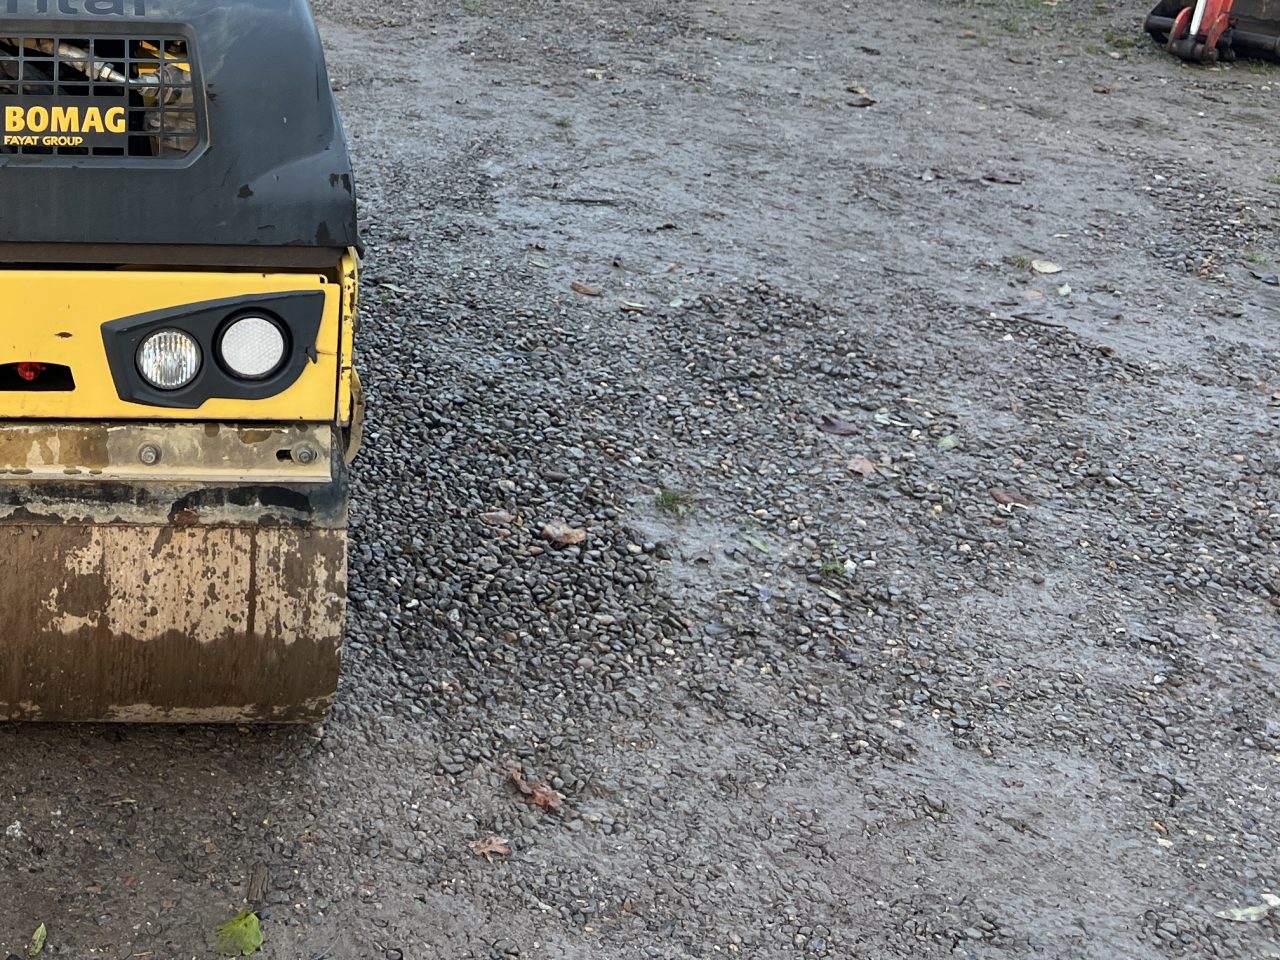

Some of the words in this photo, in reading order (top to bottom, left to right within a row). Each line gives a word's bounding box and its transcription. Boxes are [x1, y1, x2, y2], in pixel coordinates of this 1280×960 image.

[5, 106, 126, 133] BOMAG
[3, 135, 39, 145] FAYAT
[42, 135, 83, 146] GROUP
